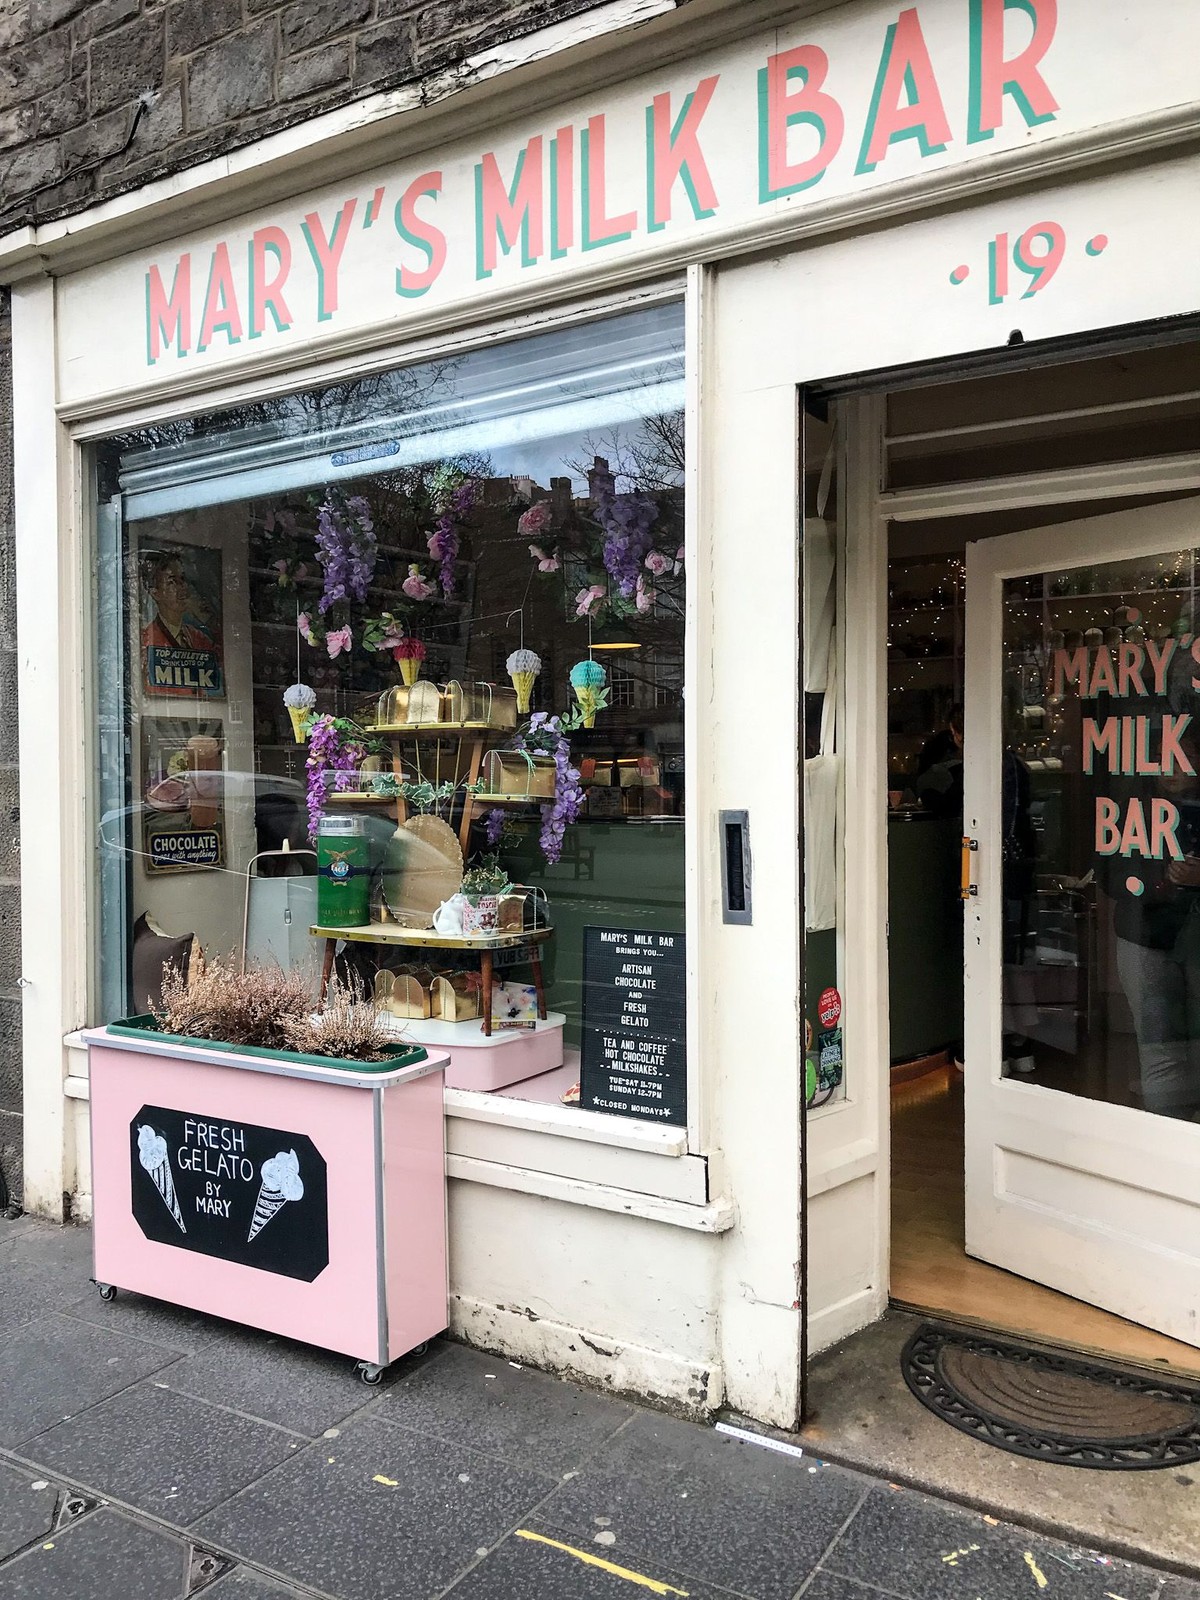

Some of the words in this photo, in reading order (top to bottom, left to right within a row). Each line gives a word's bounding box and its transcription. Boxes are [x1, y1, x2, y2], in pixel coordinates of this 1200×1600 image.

[144, 171, 449, 366] MARY'S
[475, 74, 721, 281] MILK
[757, 0, 1062, 205] BAR
[987, 220, 1067, 306] 19
[155, 649, 171, 658] TOP
[171, 651, 210, 661] ATHLETES
[155, 665, 215, 688] MILK
[1082, 713, 1198, 777] MILK
[1095, 796, 1186, 862] BAR
[153, 836, 217, 852] CHOCOLATE
[172, 850, 186, 860] with
[186, 849, 217, 863] anything
[600, 932, 628, 944] MARY'S
[634, 934, 653, 945] MILK
[659, 936, 674, 947] BAR
[615, 946, 641, 955] BRINGS
[621, 963, 653, 975] ARTISAN
[614, 976, 657, 990] CHOCOLATE
[628, 991, 643, 999] AND
[623, 1001, 647, 1014] FRESH
[821, 1008, 836, 1023] yelp
[620, 1015, 649, 1028] GELATO
[603, 1037, 617, 1048] TEA
[620, 1039, 635, 1051] AND
[638, 1042, 668, 1055] COFFEE
[604, 1048, 619, 1059] HOT
[622, 1051, 665, 1066] CHOCOLATE
[608, 1084, 637, 1095] SUNDAY
[184, 1118, 245, 1153] FRESH
[177, 1146, 254, 1182] GELATO
[205, 1181, 222, 1198] BY
[195, 1196, 232, 1219] MARY
